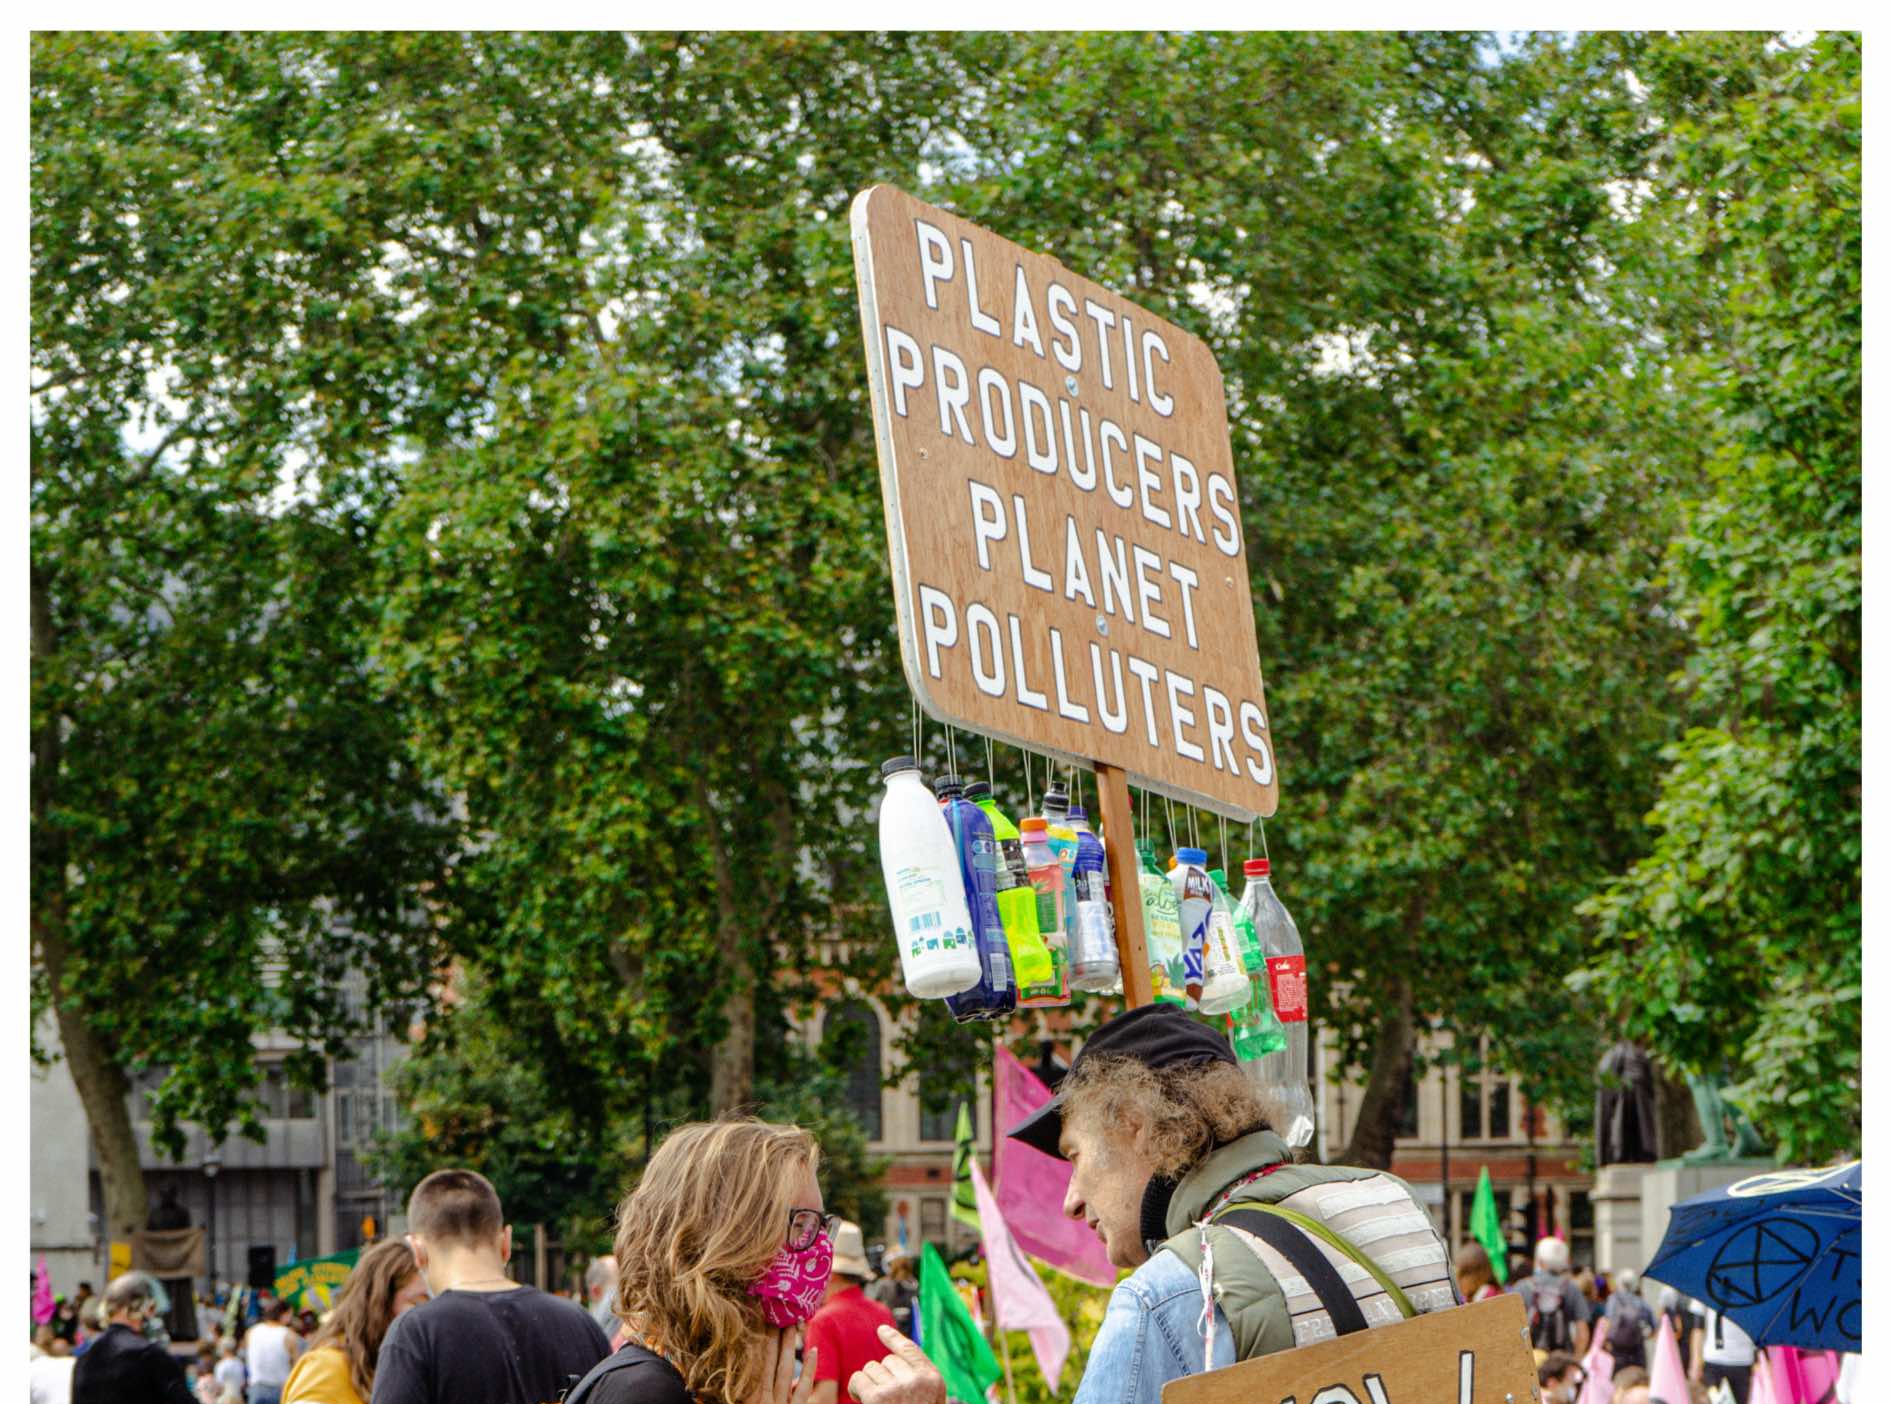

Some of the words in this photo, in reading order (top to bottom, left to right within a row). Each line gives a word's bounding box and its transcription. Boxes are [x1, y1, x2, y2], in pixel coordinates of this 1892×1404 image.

[914, 218, 1175, 418] PLASTIC
[886, 325, 1241, 558] PRODUCERS
[968, 479, 1200, 651] PLANET
[919, 584, 1272, 787] POLLUTERS
